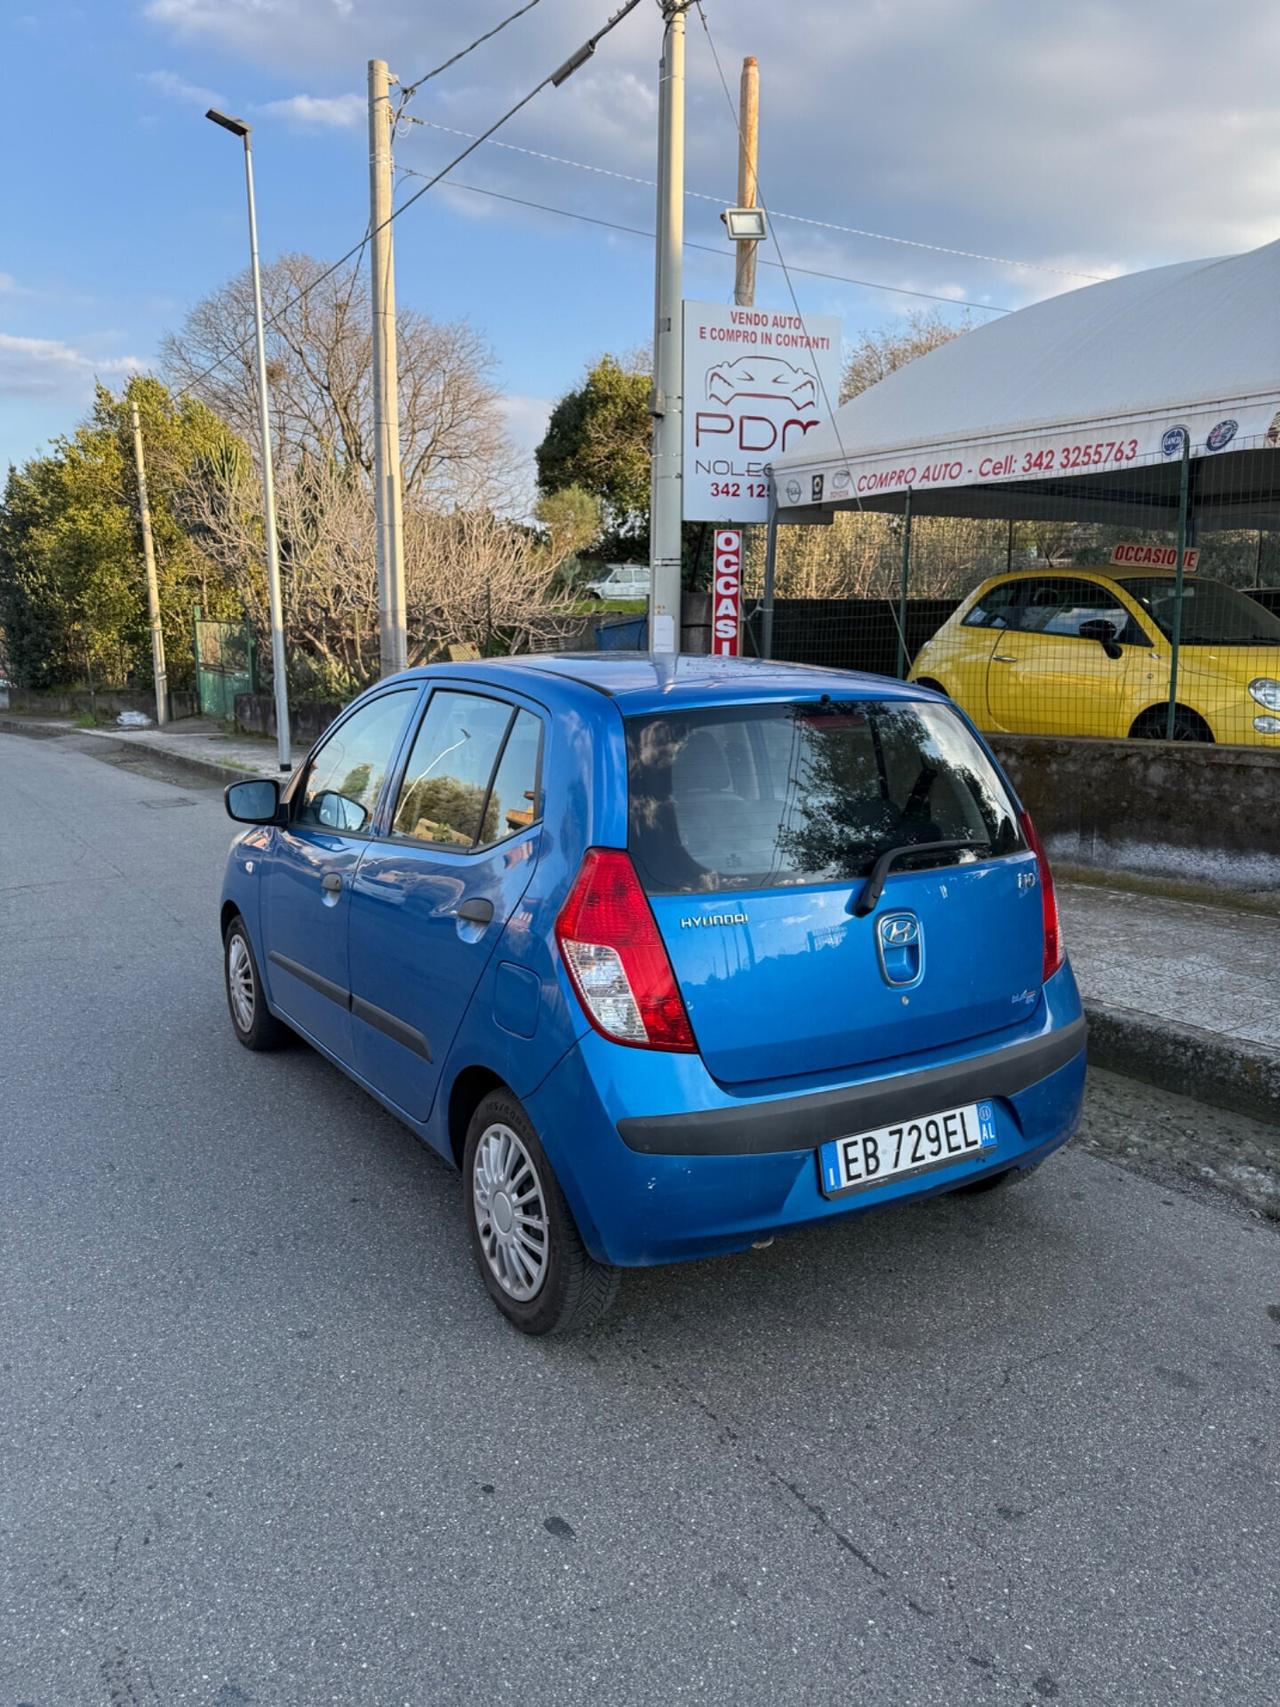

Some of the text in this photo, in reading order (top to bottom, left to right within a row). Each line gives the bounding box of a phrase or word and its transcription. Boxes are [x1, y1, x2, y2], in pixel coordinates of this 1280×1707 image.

[730, 311, 802, 330] VENDO AUTO
[699, 326, 830, 350] E COMPRO IN CONTANTI
[857, 467, 917, 492] COMPRO
[919, 461, 963, 483] AUTO
[978, 455, 1017, 477] Cell:
[1021, 450, 1055, 473] 342
[1060, 439, 1138, 469] 3255763
[710, 482, 740, 497] 342
[746, 483, 770, 498] 12
[680, 913, 748, 929] HYUNDAI
[842, 1136, 880, 1183] EB
[888, 1111, 979, 1170] 729EL
[982, 1122, 996, 1141] AL
